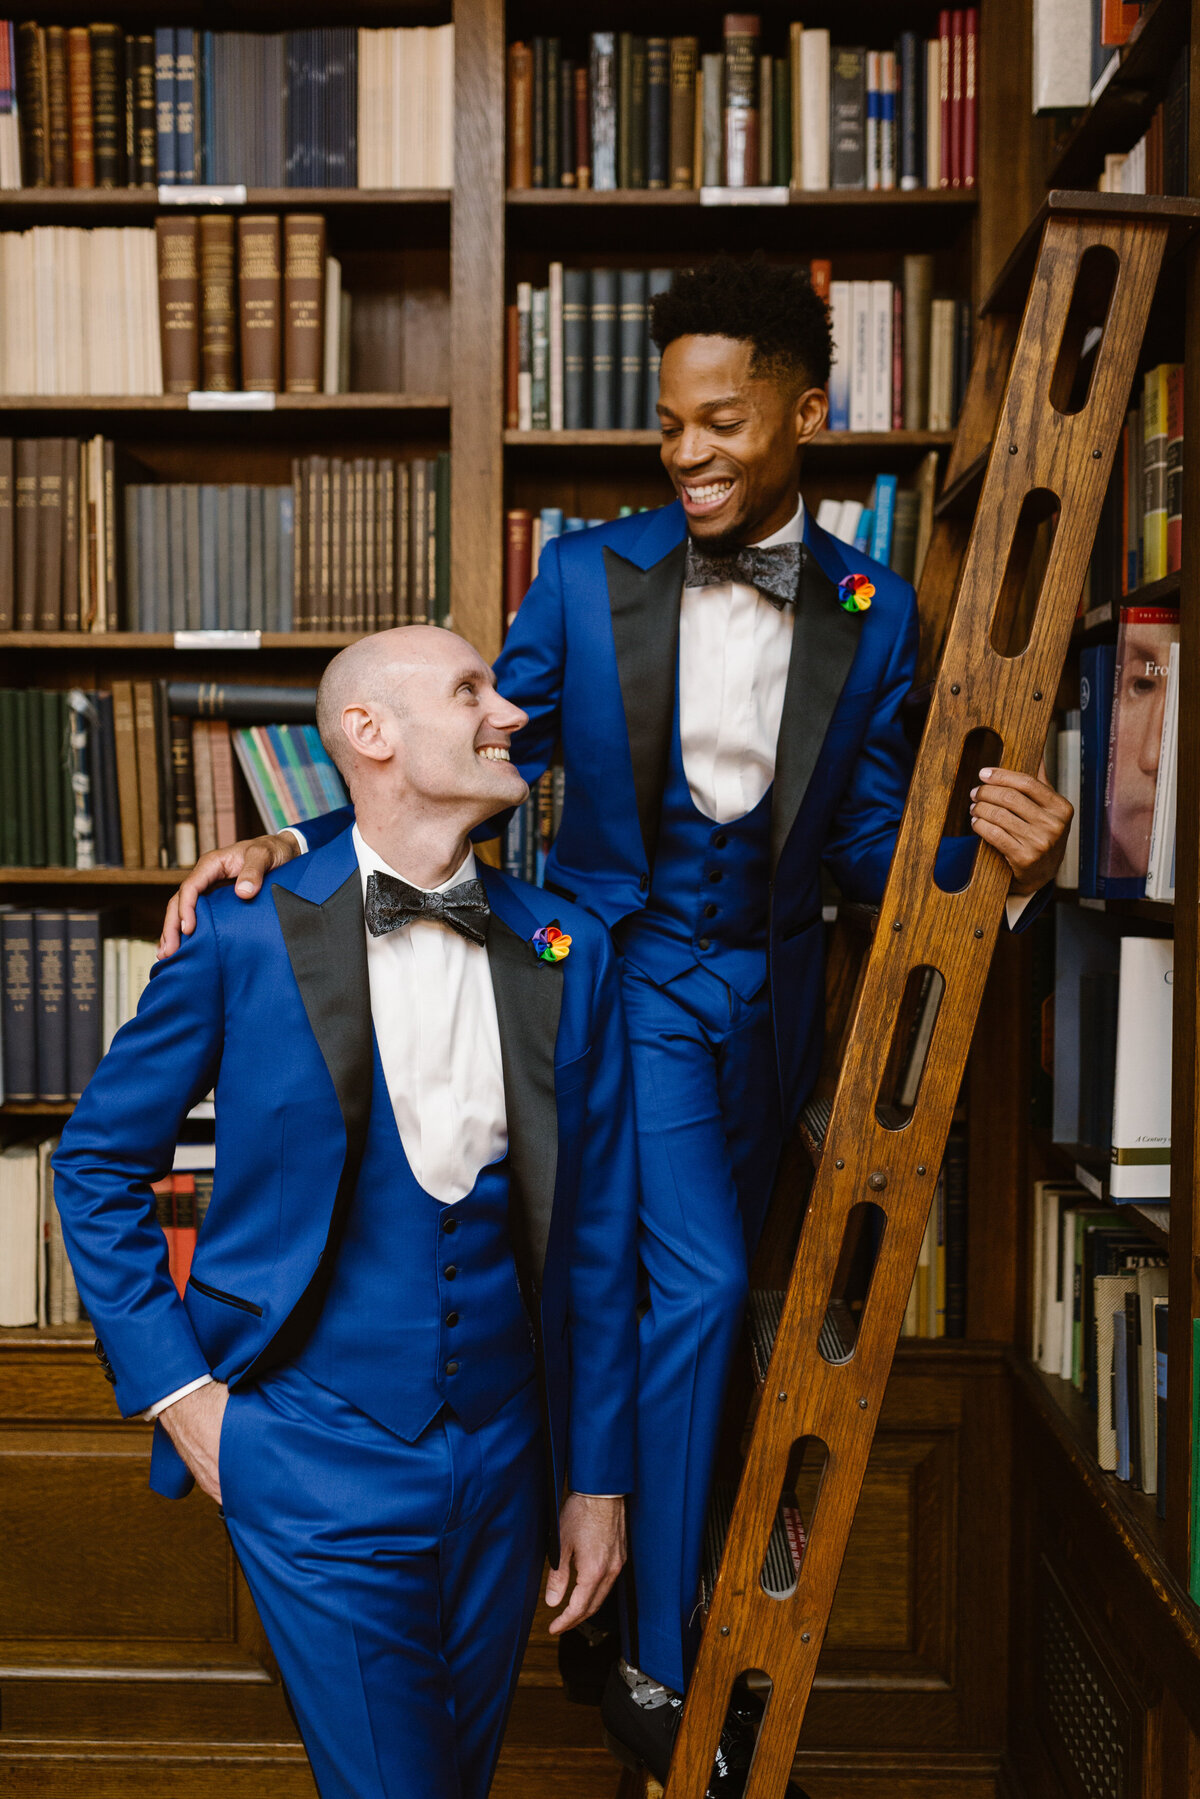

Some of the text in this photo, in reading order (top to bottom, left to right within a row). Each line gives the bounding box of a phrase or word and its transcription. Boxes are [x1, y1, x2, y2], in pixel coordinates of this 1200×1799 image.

[1113, 664, 1122, 695] From
[1144, 661, 1169, 677] Fro
[1109, 697, 1119, 743] Strength
[1104, 762, 1114, 808] Strength
